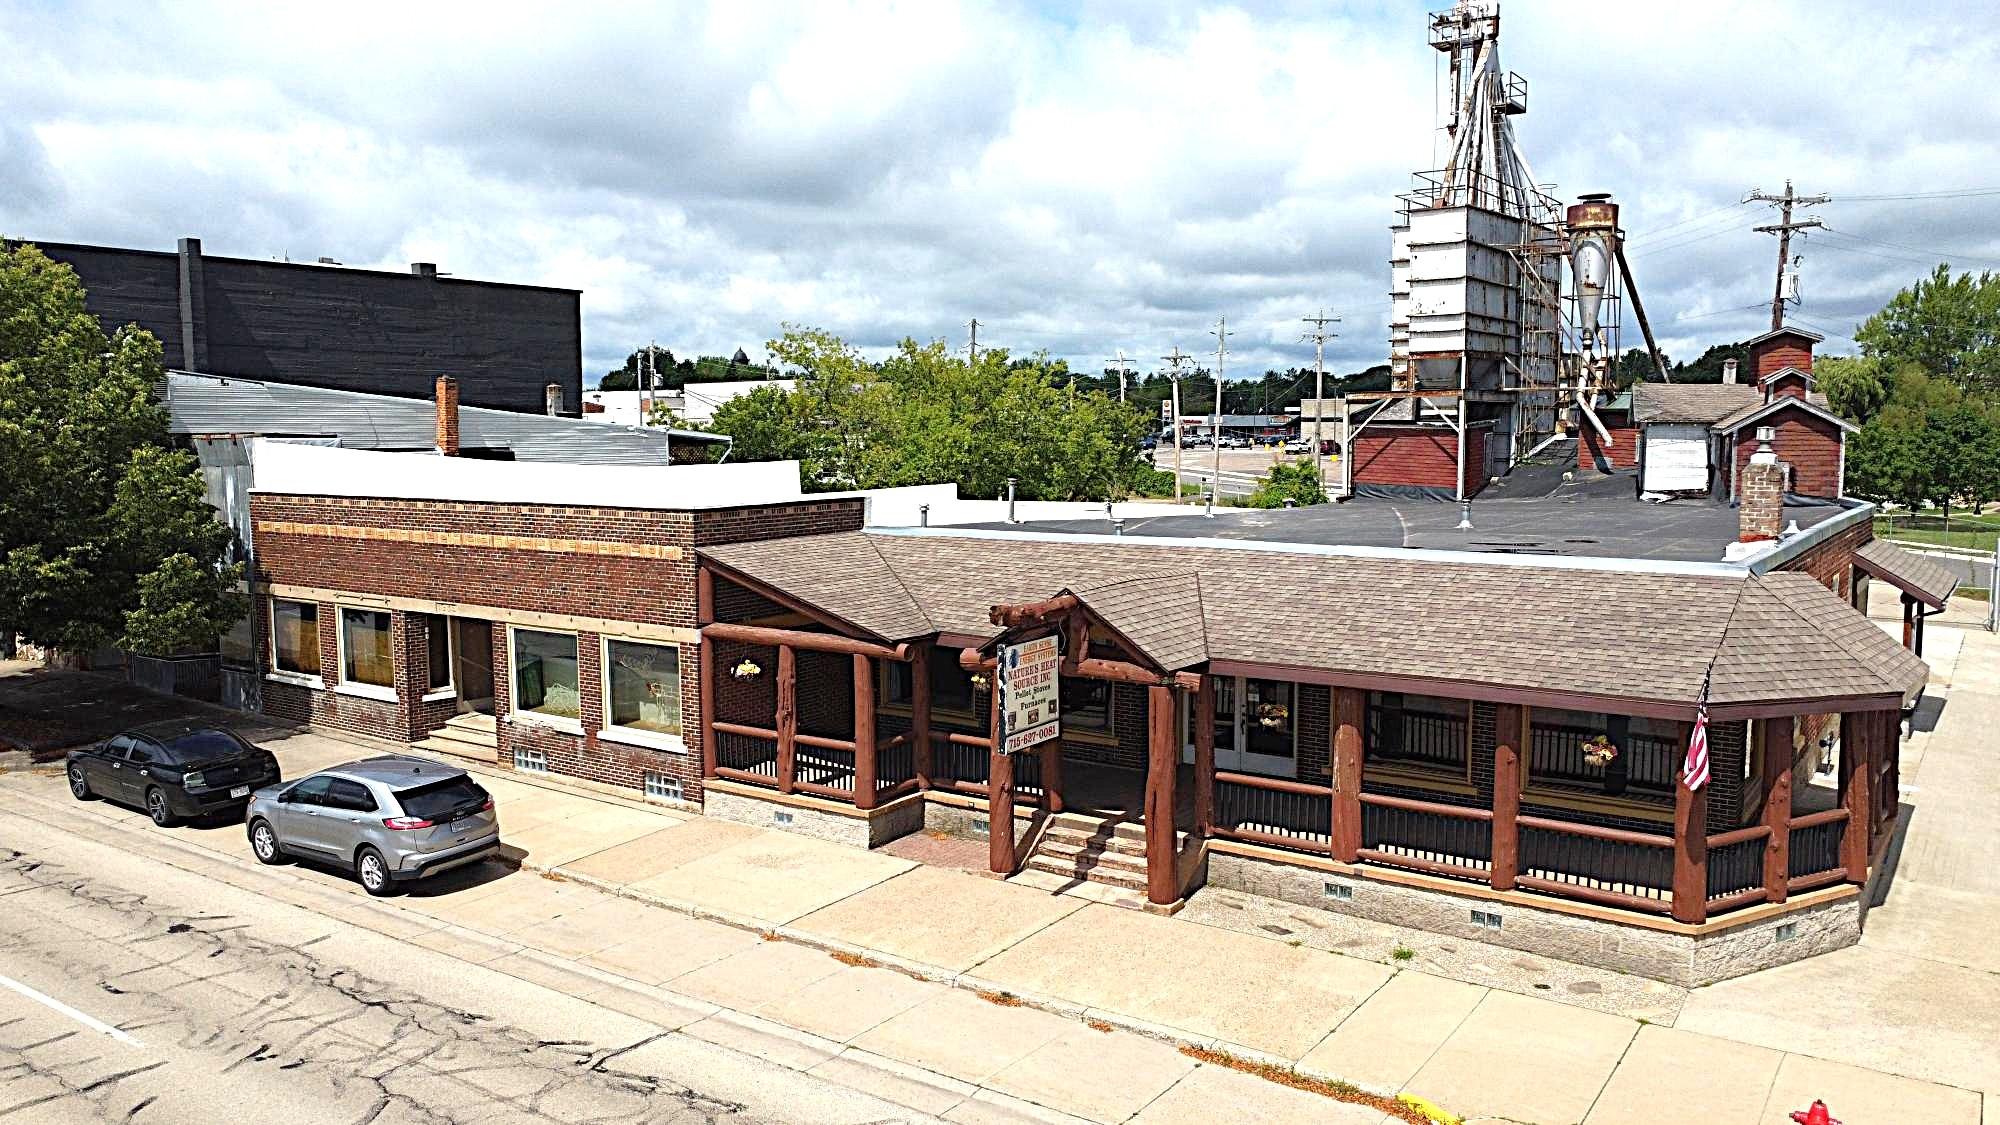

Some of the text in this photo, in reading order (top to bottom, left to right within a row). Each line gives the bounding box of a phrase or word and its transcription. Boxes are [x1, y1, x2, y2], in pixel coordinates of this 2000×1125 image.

[1041, 659, 1057, 671] HEAT
[1013, 675, 1039, 690] SOURCE
[1015, 684, 1051, 699] Pellet Stoves
[1021, 698, 1046, 710] Furnaces
[1008, 725, 1056, 749] 715-627-0081
